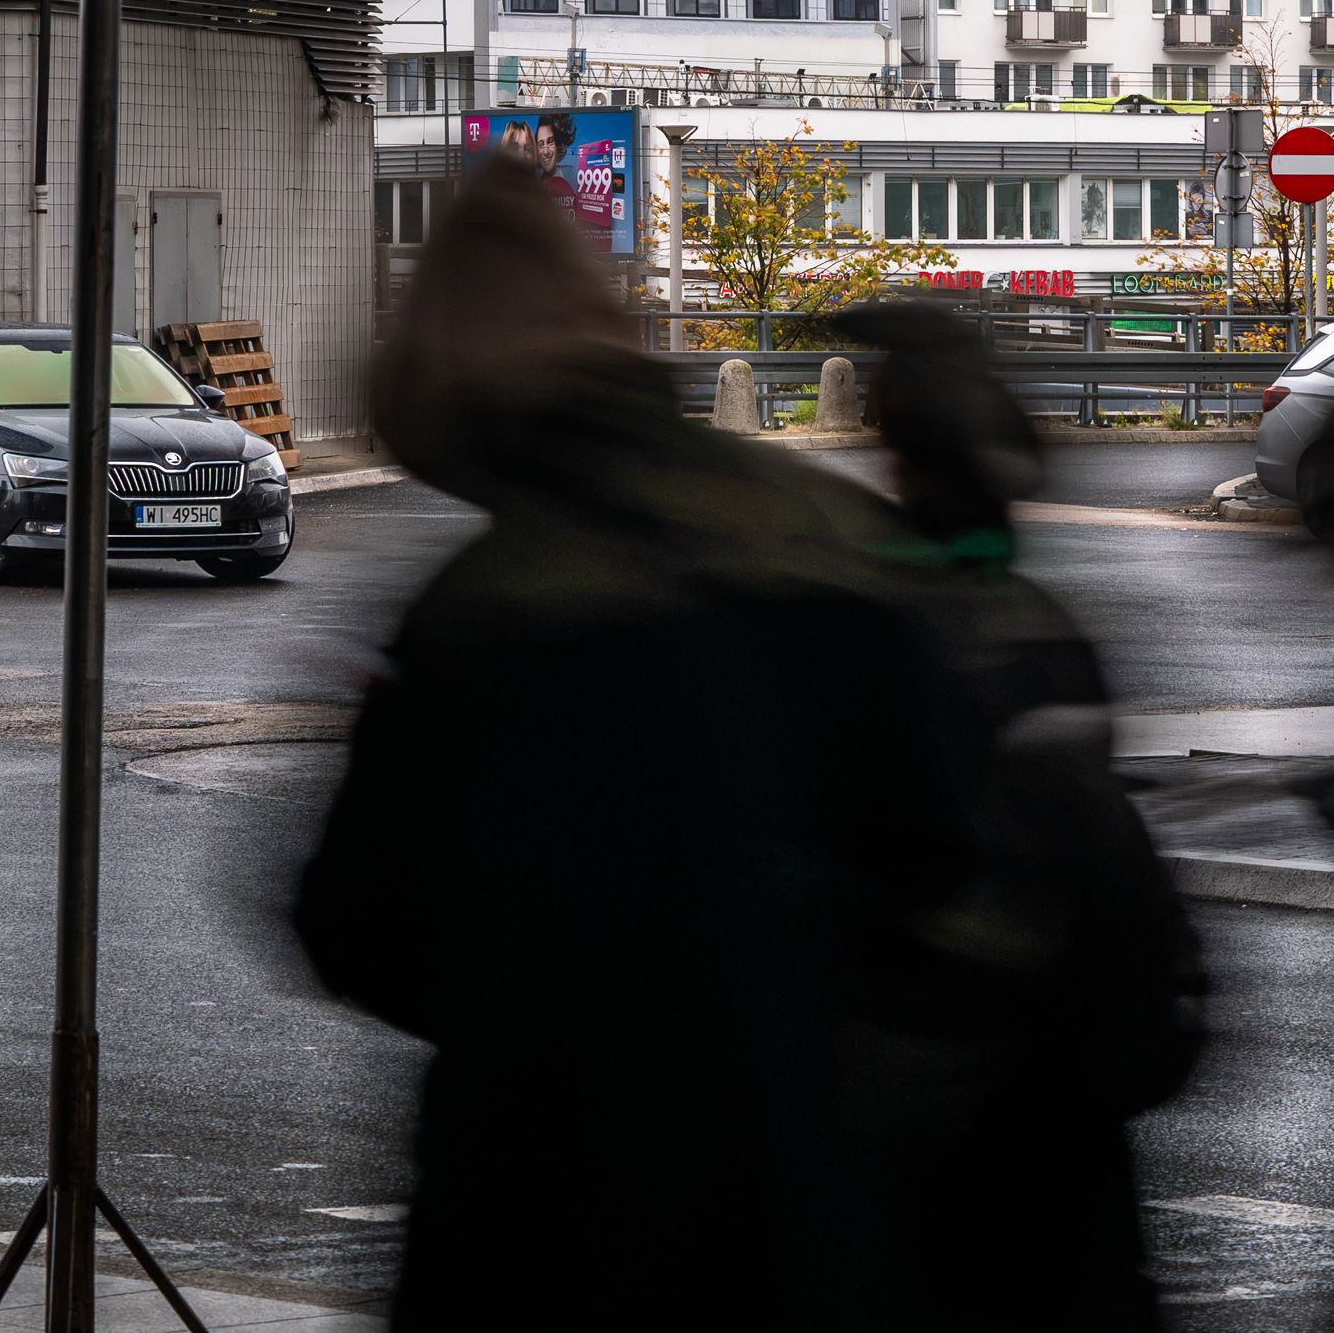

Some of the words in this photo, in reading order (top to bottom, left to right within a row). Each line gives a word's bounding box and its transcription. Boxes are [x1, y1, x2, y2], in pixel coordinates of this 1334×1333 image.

[577, 167, 612, 195] 9999
[1010, 269, 1074, 298] KEBAB
[147, 508, 164, 523] WI
[173, 507, 218, 523] 495HC
